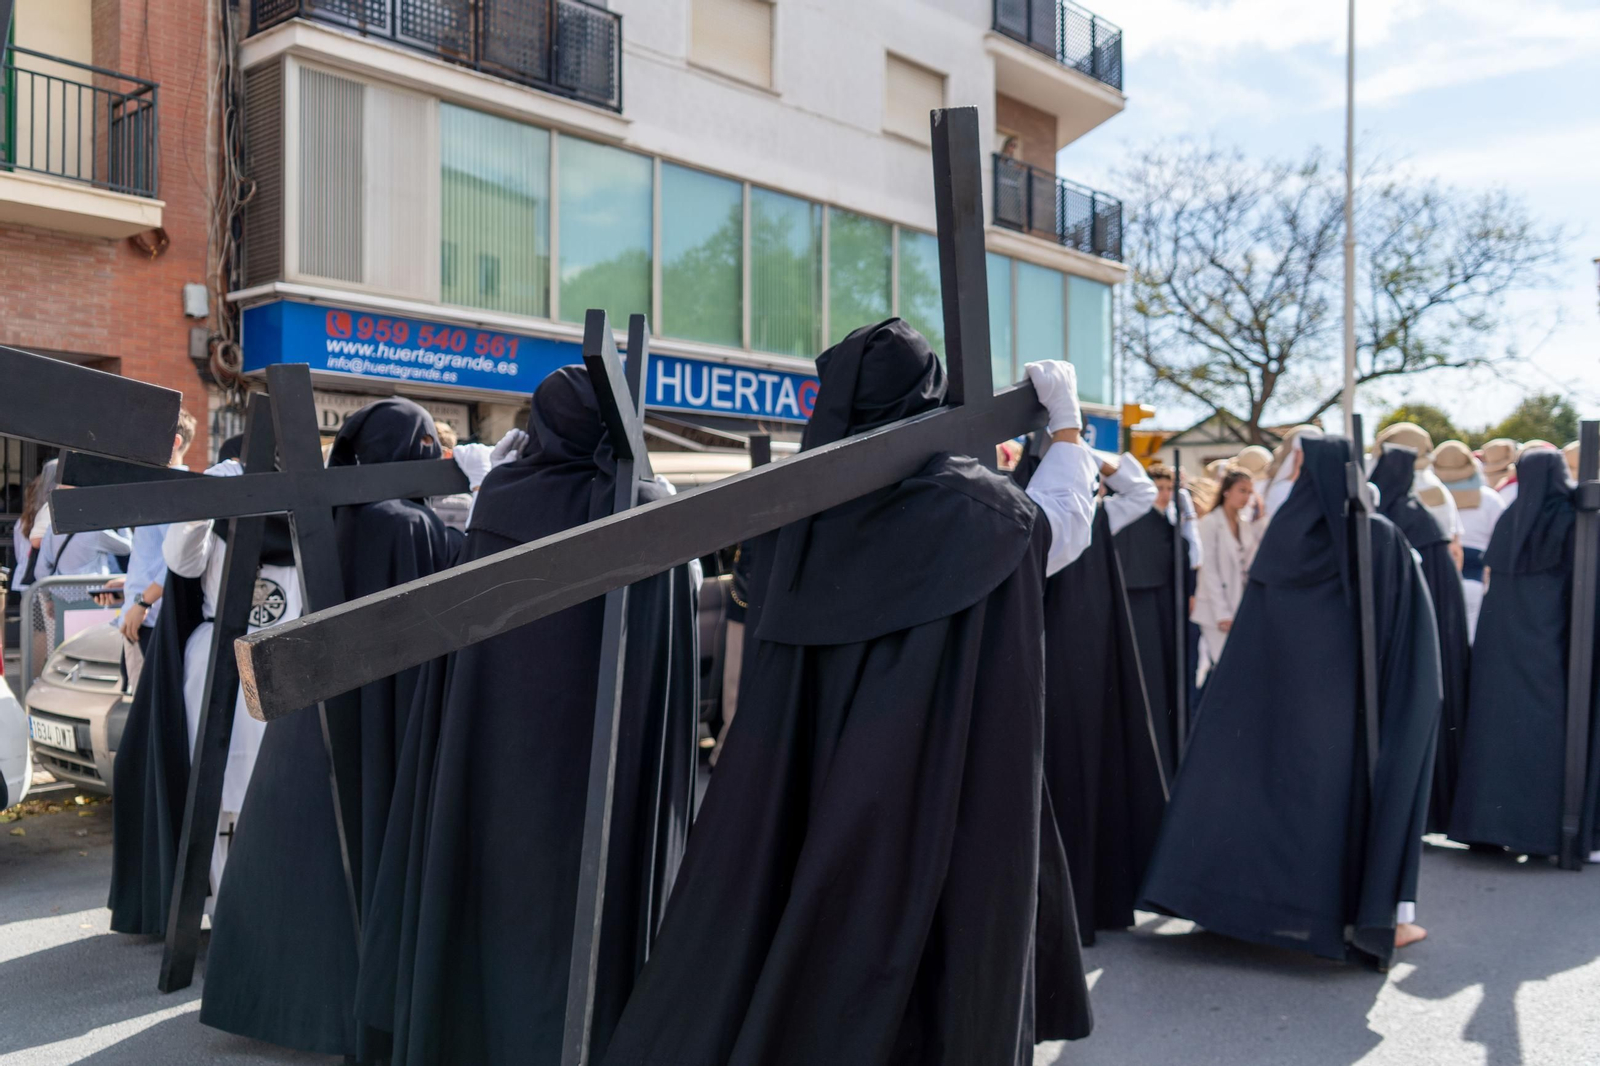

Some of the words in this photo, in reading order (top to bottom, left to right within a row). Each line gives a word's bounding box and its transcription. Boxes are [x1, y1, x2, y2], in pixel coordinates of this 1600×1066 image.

[357, 317, 409, 344] 959
[418, 325, 467, 352] 540
[474, 333, 519, 359] 561
[326, 340, 518, 375] www.huertagrande.es
[326, 355, 457, 382] info@huertagrande.es
[656, 360, 820, 417] HUERTAG
